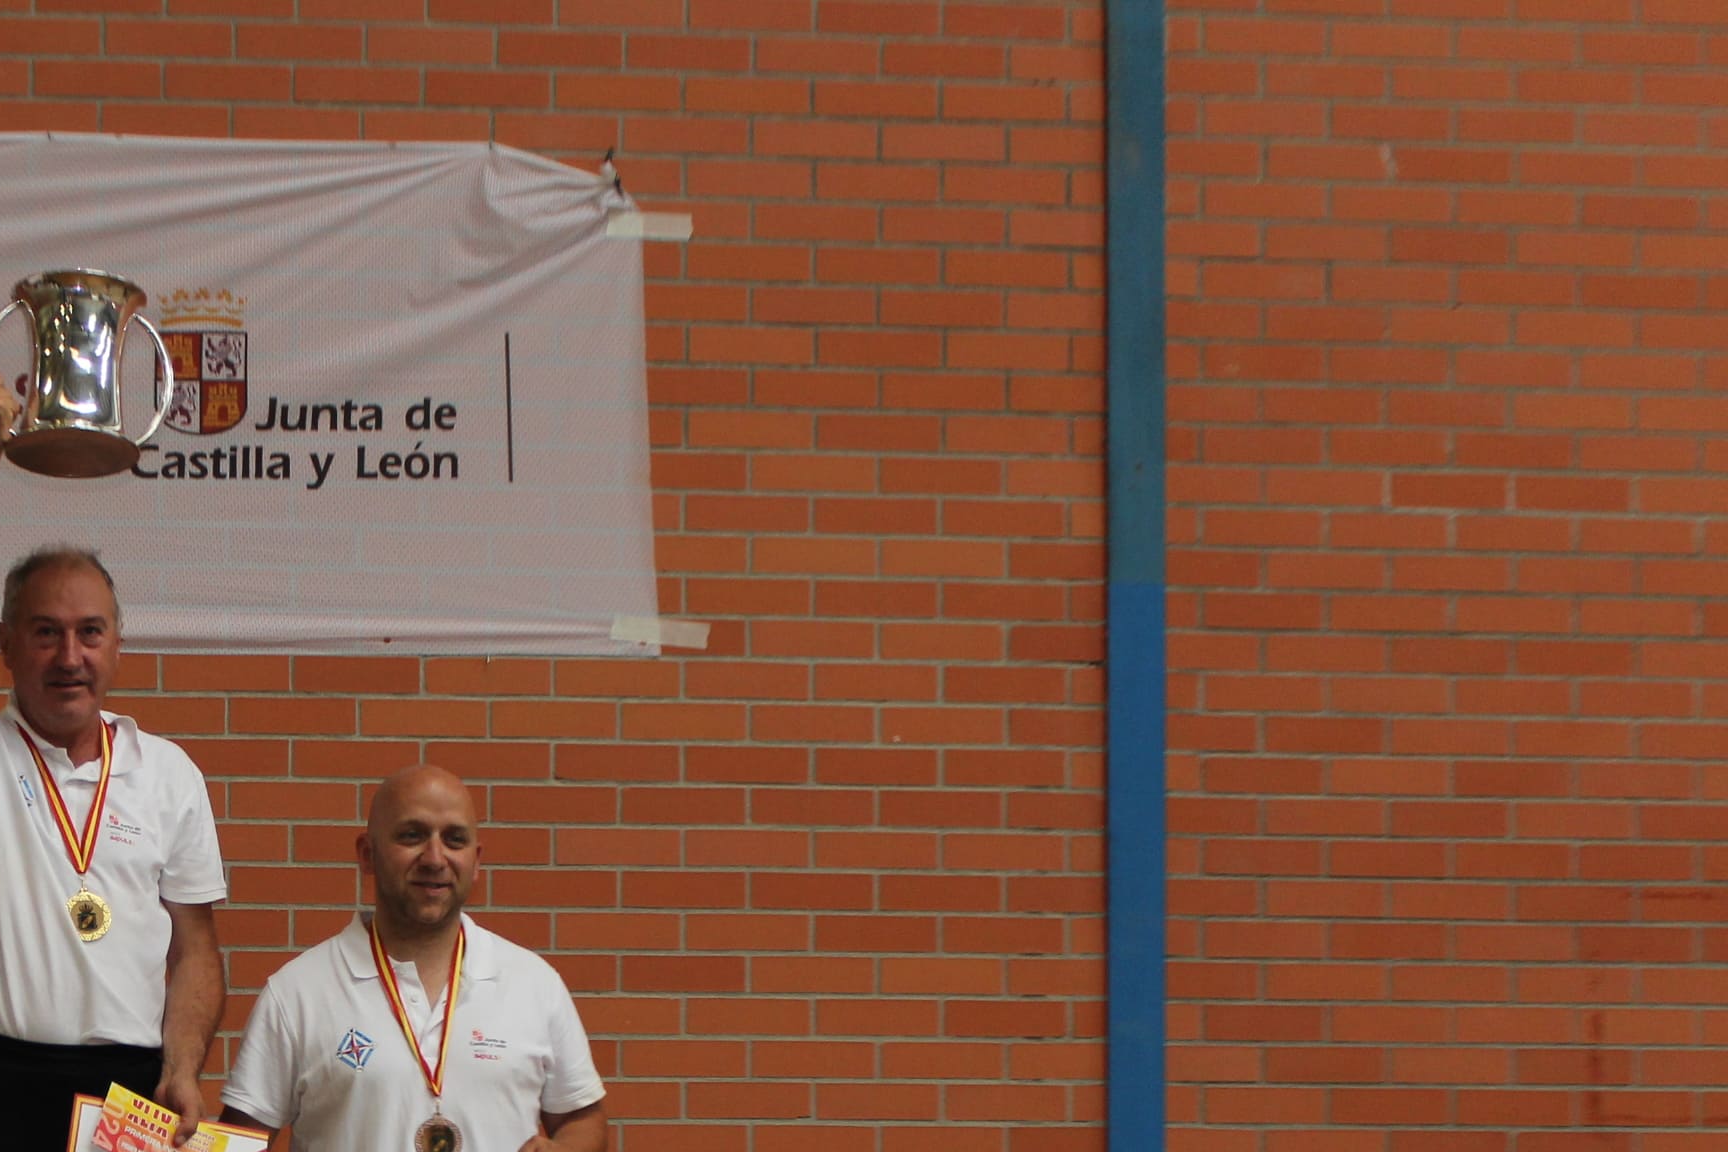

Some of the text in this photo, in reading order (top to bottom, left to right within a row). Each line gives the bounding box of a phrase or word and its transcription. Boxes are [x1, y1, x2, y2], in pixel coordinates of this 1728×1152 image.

[255, 397, 457, 431] Junta de
[132, 442, 459, 489] Castilla y León
